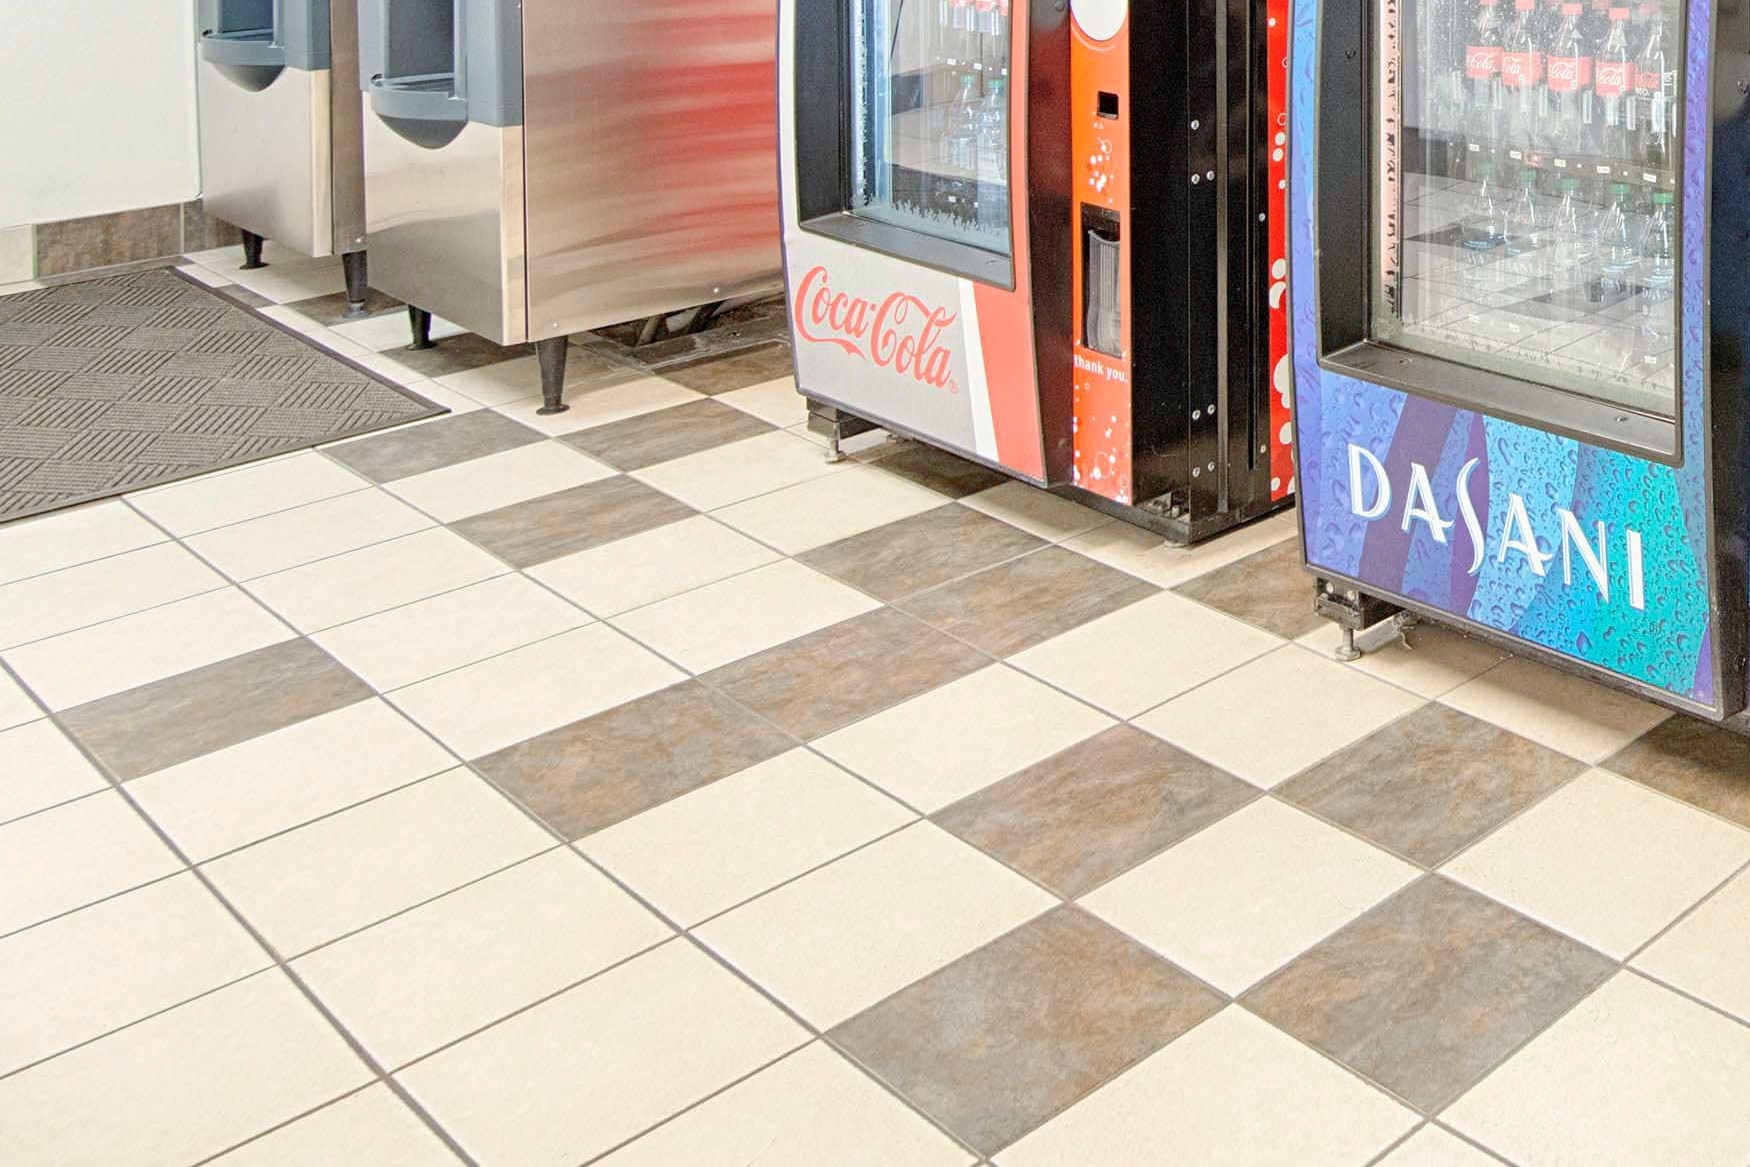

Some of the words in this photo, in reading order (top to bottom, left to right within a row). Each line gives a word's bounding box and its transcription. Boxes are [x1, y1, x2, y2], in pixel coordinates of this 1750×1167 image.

[794, 265, 957, 389] Coca-Cola
[1073, 355, 1104, 381] thank
[1105, 364, 1128, 384] you.
[1347, 442, 1647, 611] DASANI
